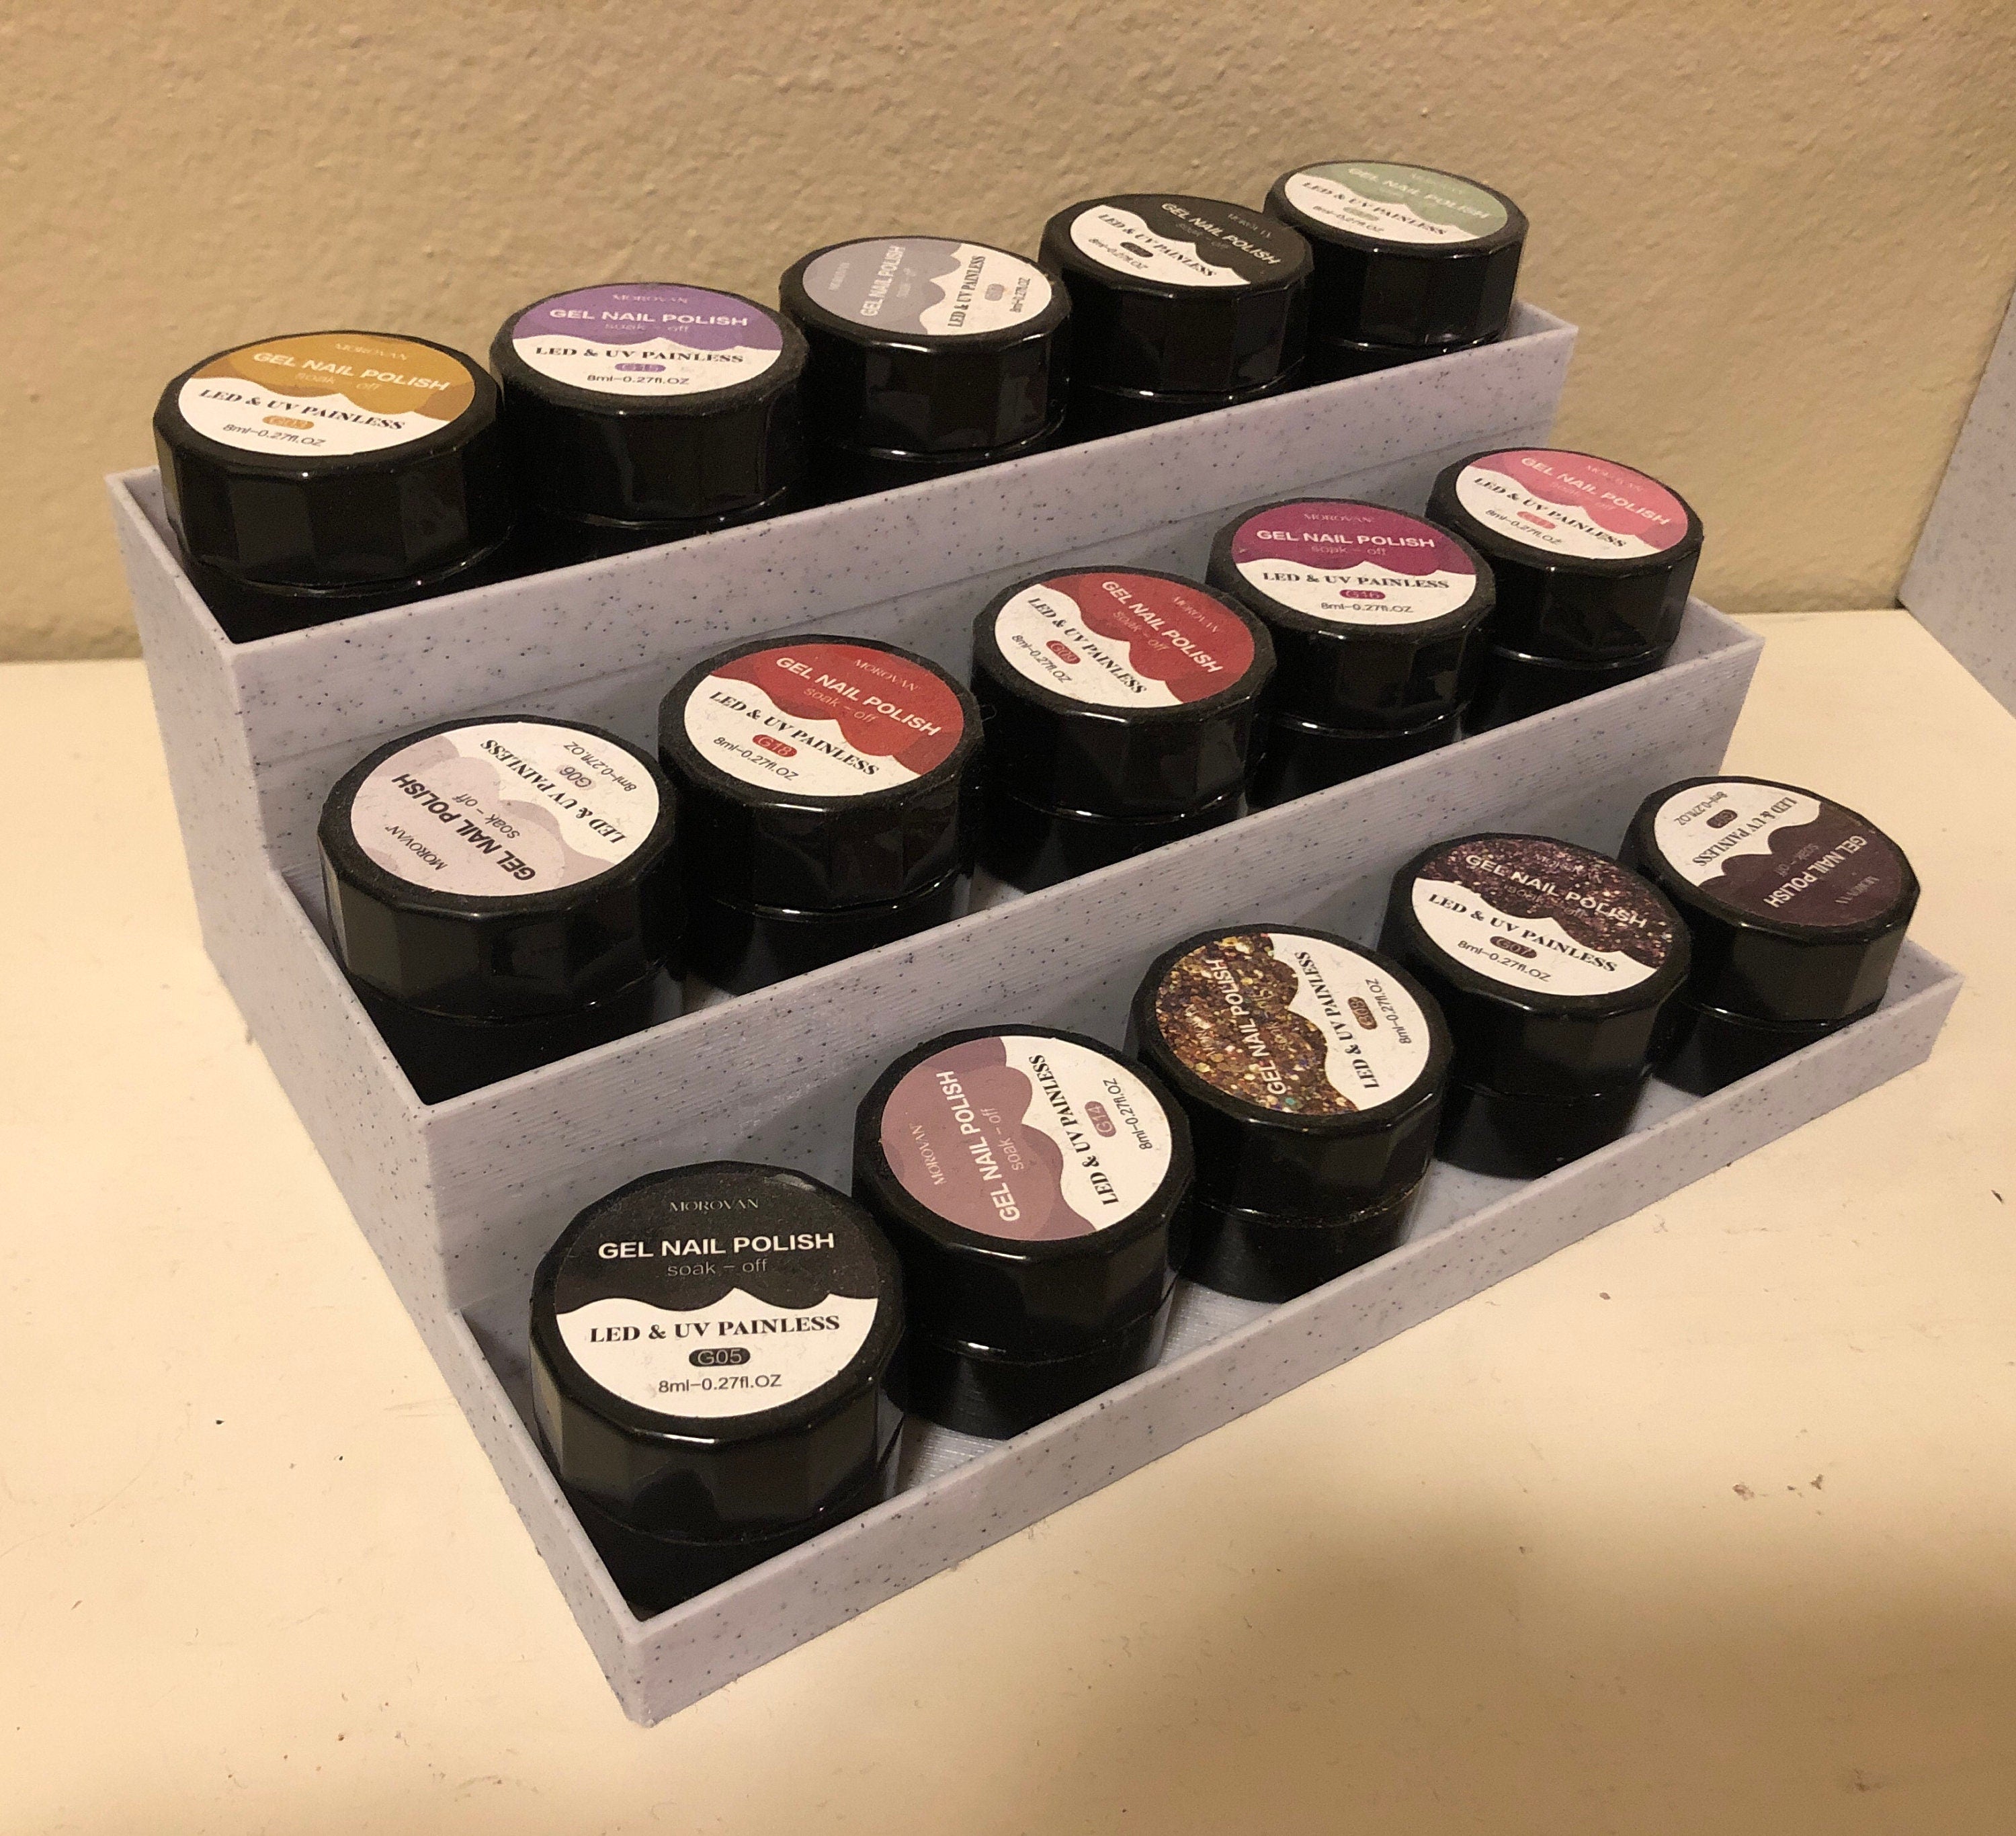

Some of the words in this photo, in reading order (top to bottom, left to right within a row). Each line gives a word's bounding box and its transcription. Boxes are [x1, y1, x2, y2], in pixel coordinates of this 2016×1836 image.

[549, 309, 595, 319] GEL
[601, 311, 656, 322] NAIL
[662, 314, 747, 325] POLISH
[253, 351, 296, 366] GEL
[301, 360, 355, 376] NAIL
[360, 369, 450, 390] POLISH
[535, 346, 577, 356] LED
[583, 348, 599, 357] &
[605, 349, 636, 358] UV
[641, 351, 743, 362] PAINLESS
[198, 388, 243, 402] LED
[245, 397, 261, 406] &
[266, 399, 300, 411] UV
[300, 405, 406, 429] PAINLESS
[1256, 530, 1299, 541] GEL
[1302, 532, 1353, 544] NAIL
[1356, 535, 1435, 548] POLISH
[1262, 572, 1300, 581] LED
[1306, 573, 1320, 583] &
[1324, 575, 1351, 584] UV
[1356, 576, 1450, 589] PAINLESS
[1101, 581, 1133, 604] GEL
[1128, 603, 1166, 631] NAIL
[1161, 629, 1223, 673] POLISH
[1112, 611, 1142, 632] soak
[1147, 639, 1170, 651] off
[1027, 597, 1057, 618] LED
[1051, 618, 1067, 628] &
[1063, 627, 1089, 641] UV
[1081, 643, 1148, 694] PAINLESS
[853, 659, 918, 691] MOROVAN
[776, 657, 813, 679] GEL
[814, 674, 861, 701] NAIL
[862, 696, 942, 735] POLISH
[803, 687, 841, 707] soak
[853, 711, 879, 722] off
[709, 691, 747, 711] LED
[745, 708, 761, 720] &
[763, 716, 794, 731] UV
[790, 729, 880, 775] PAINLESS
[479, 739, 556, 792] PAINLESS
[390, 774, 462, 823] POLISH
[452, 793, 478, 807] off
[547, 792, 578, 810] UV
[575, 806, 593, 819] &
[1759, 810, 1776, 819] &
[1770, 796, 1798, 814] LED
[455, 819, 503, 854] NAIL
[484, 814, 521, 839] soak
[588, 818, 626, 843] LED
[1745, 817, 1767, 833] UV
[388, 825, 447, 870] MOROVAN
[1691, 827, 1751, 866] PAINLESS
[1835, 835, 1867, 853] GEL
[496, 849, 536, 881] GEL
[1806, 850, 1845, 874] NAIL
[1466, 854, 1505, 876] GEL
[1509, 870, 1559, 897] NAIL
[1564, 890, 1648, 928] POLISH
[1763, 870, 1818, 909] POLISH
[1428, 893, 1467, 913] LED
[1470, 910, 1484, 921] &
[1490, 916, 1519, 932] UV
[1520, 929, 1618, 972] PAINLESS
[1207, 958, 1250, 1015] POLISH
[1294, 951, 1342, 1017] PAINLESS
[1238, 1017, 1270, 1057] NAIL
[1329, 1020, 1353, 1041] UV
[1344, 1043, 1361, 1054] &
[1258, 1059, 1287, 1095] GEL
[1352, 1058, 1380, 1089] LED
[935, 1071, 981, 1135] POLISH
[1027, 1054, 1079, 1127] PAINLESS
[980, 1108, 1001, 1124] off
[911, 1125, 946, 1185] MOROVAN
[997, 1138, 1025, 1171] soak
[1066, 1130, 1091, 1153] UV
[968, 1136, 1003, 1181] NAIL
[1081, 1155, 1099, 1167] &
[989, 1181, 1020, 1222] GEL
[1089, 1171, 1119, 1205] LED
[669, 1198, 758, 1212] MOROVAN
[597, 1241, 654, 1259] GEL
[661, 1238, 726, 1257] NAIL
[733, 1233, 834, 1253] POLISH
[667, 1261, 716, 1276] soak
[742, 1257, 767, 1273] off
[590, 1326, 640, 1342] LED
[648, 1324, 667, 1340] &
[674, 1322, 710, 1338] UV
[718, 1315, 840, 1336] PAINLESS
